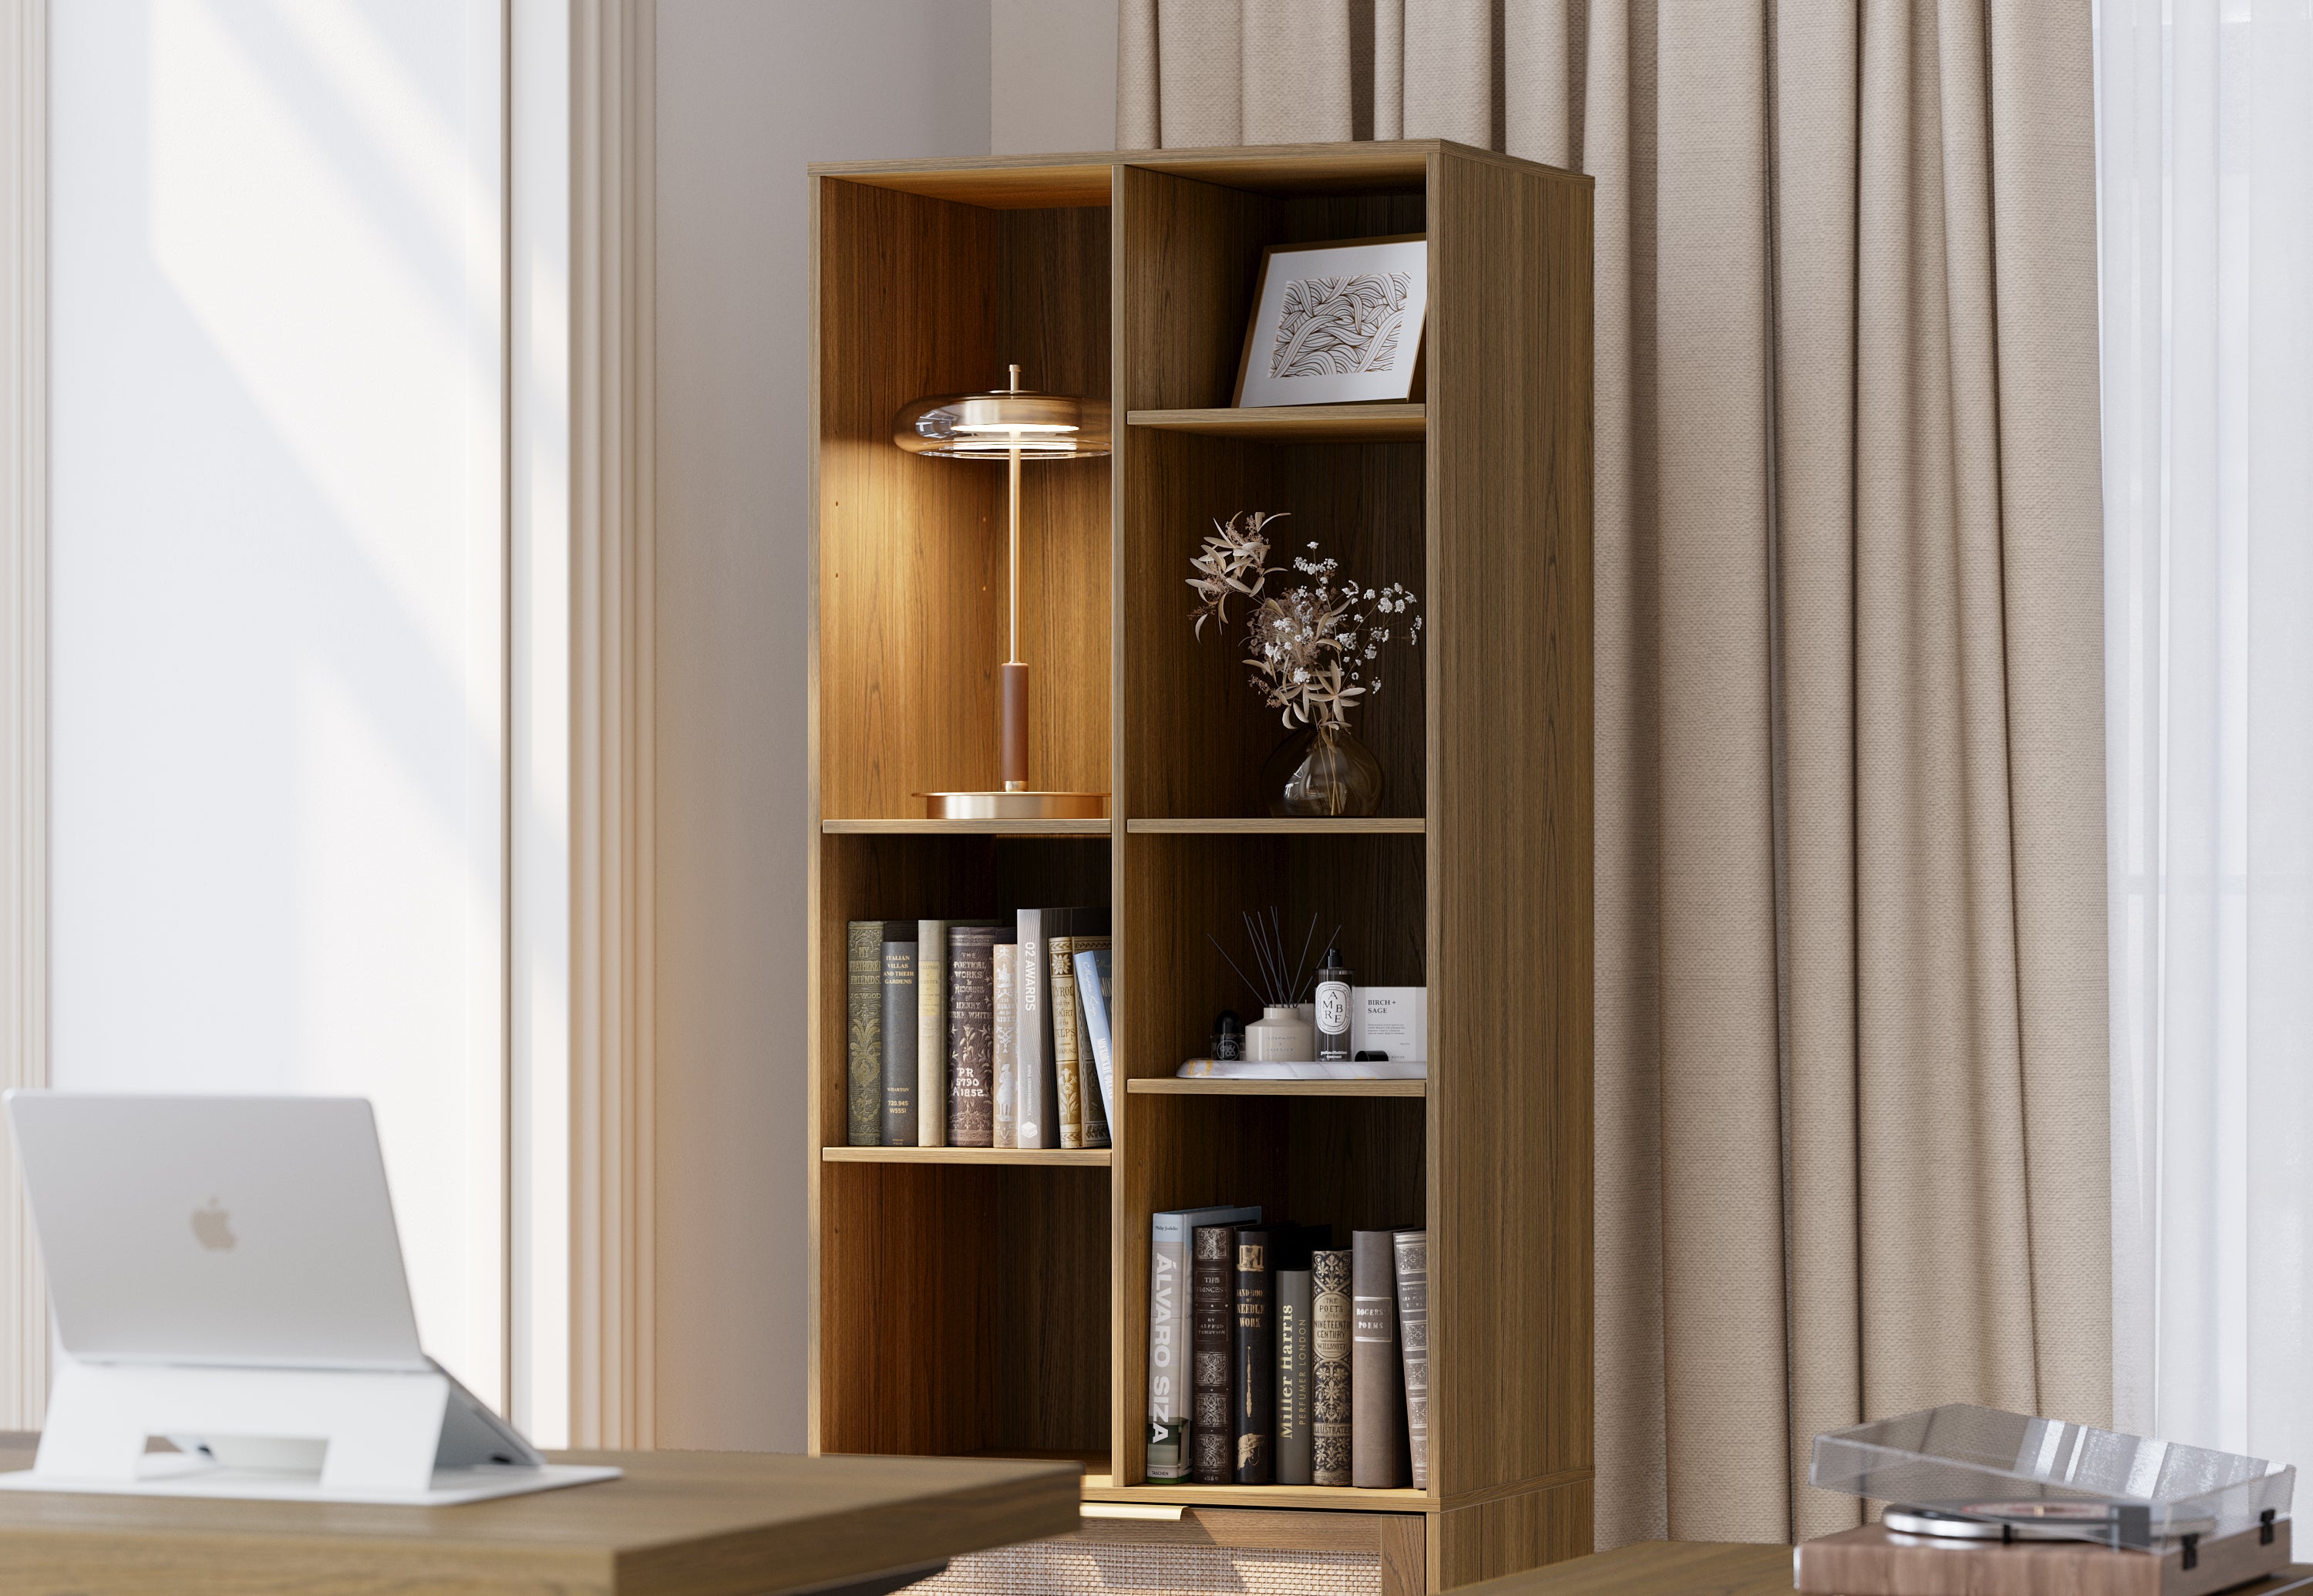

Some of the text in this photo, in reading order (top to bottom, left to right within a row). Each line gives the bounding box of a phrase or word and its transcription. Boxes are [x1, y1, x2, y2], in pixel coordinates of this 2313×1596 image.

[858, 946, 870, 957] MY
[1025, 960, 1035, 1011] AWARDS
[956, 1067, 974, 1077] PR
[1239, 1317, 1261, 1327] WORK
[1317, 1330, 1346, 1339] CENTURY
[1153, 1253, 1177, 1443] ÁLVARO SIZA
[1281, 1305, 1292, 1439] Miller Harris
